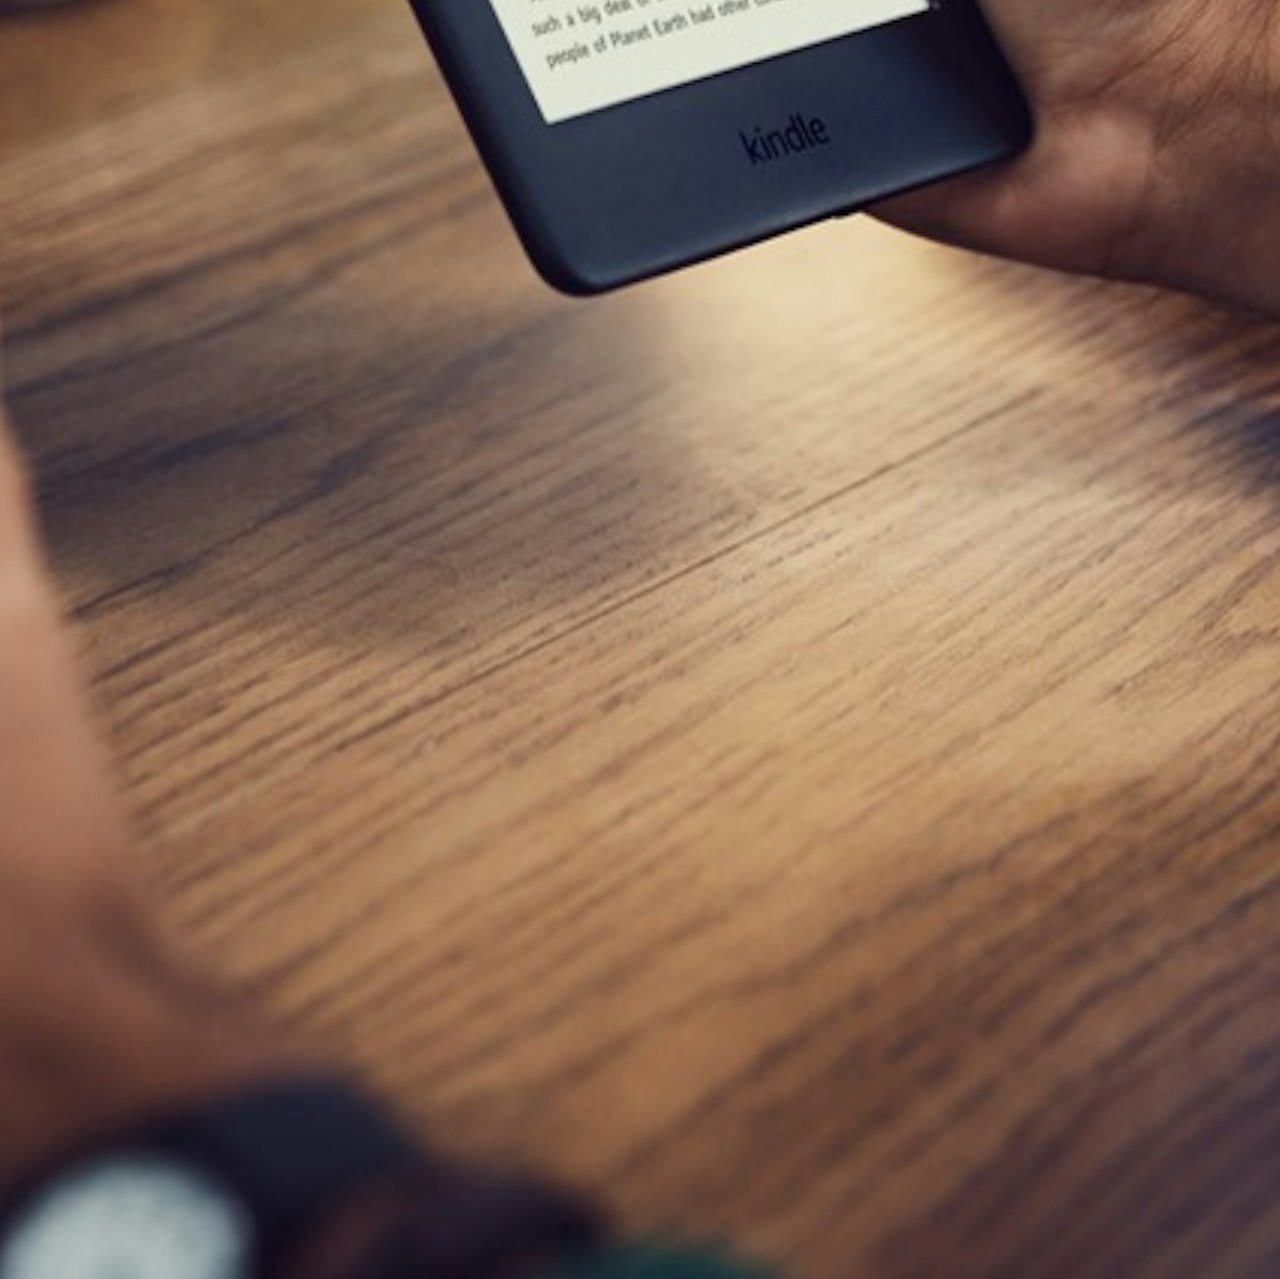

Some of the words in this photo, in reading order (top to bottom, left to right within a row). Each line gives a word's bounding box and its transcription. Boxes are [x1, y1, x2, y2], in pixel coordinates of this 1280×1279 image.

[532, 16, 561, 35] such
[577, 7, 601, 23] big
[546, 44, 588, 69] people
[593, 35, 606, 52] of
[609, 25, 651, 46] Planet
[652, 14, 687, 35] Earth
[689, 5, 714, 23] had
[738, 111, 830, 166] kindle
